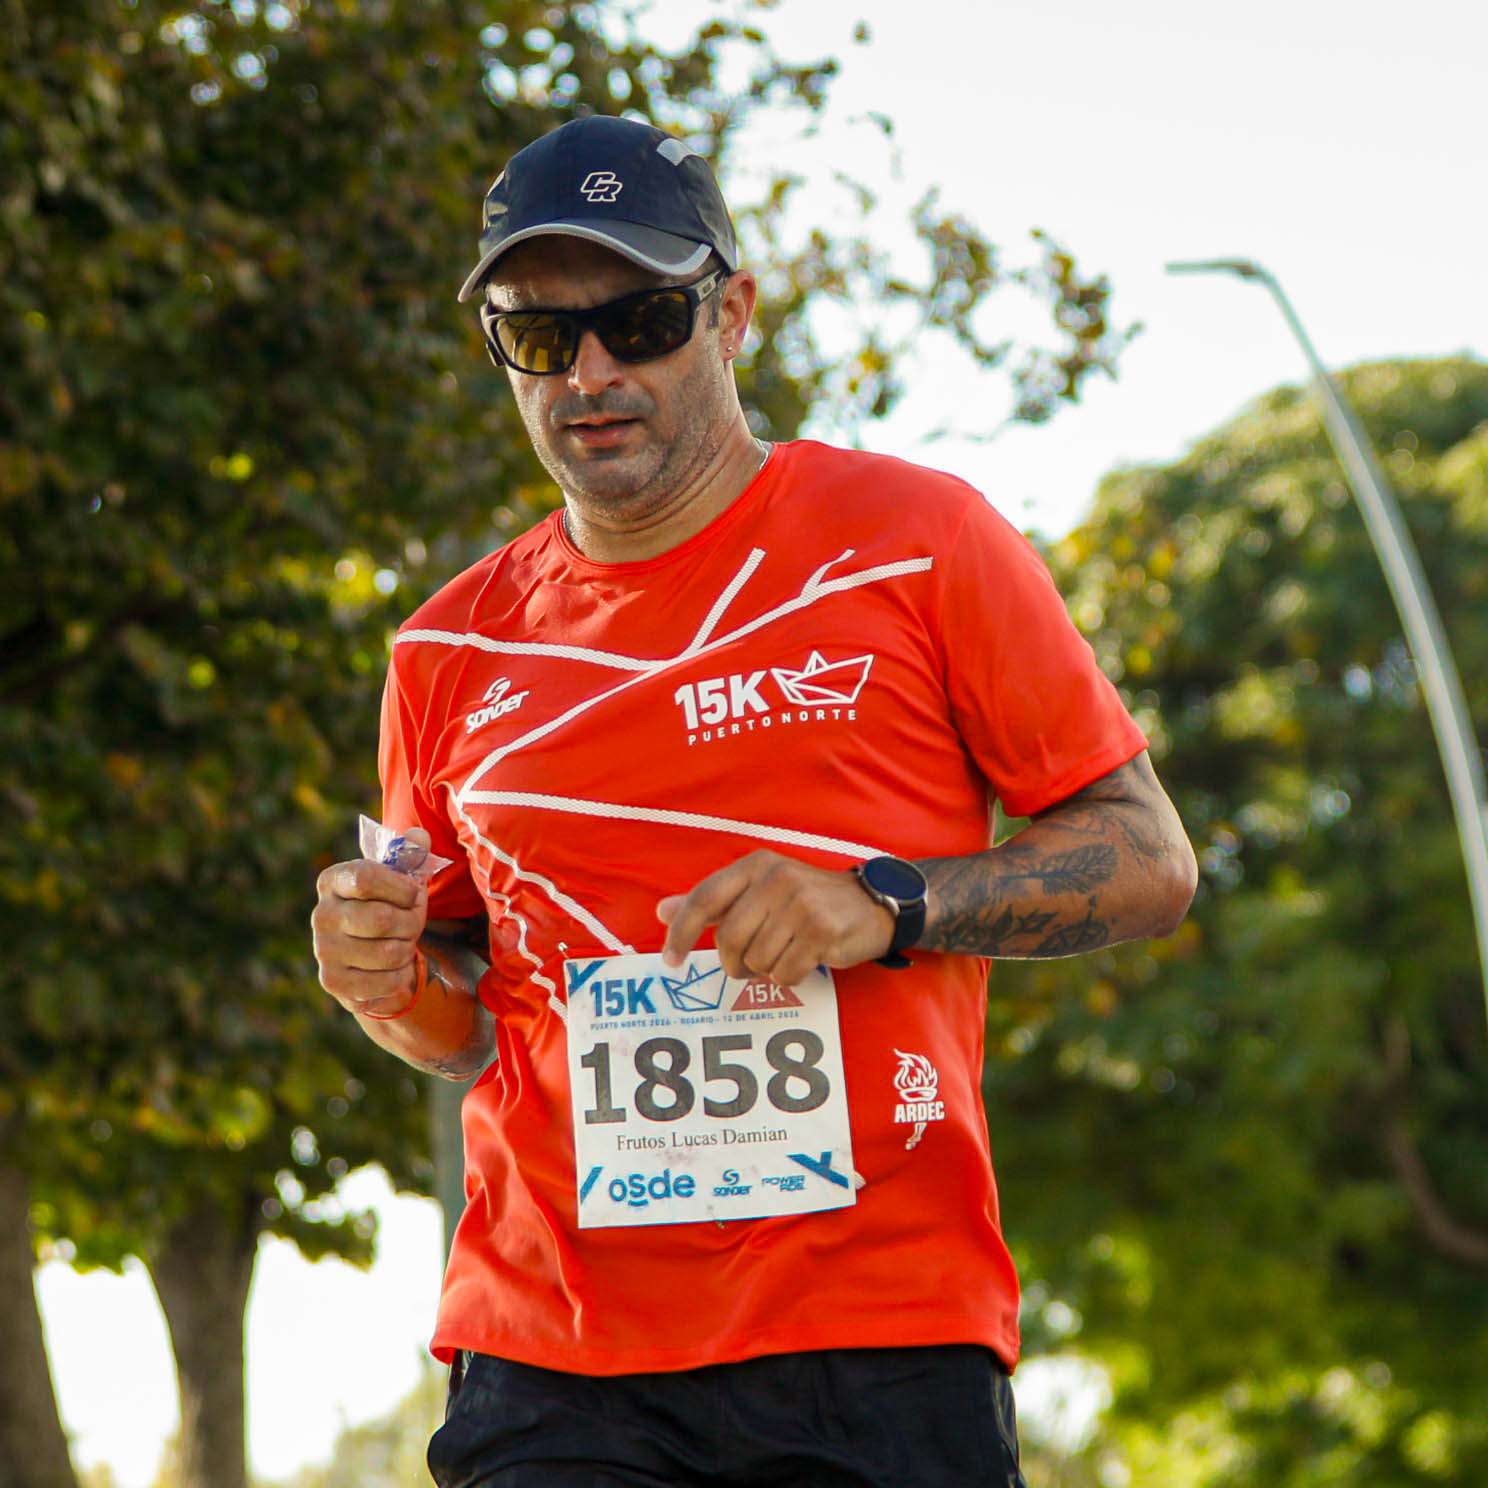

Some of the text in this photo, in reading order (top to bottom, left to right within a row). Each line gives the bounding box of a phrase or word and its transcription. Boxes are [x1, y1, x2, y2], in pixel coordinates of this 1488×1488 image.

[674, 670, 771, 730] 15K
[687, 708, 857, 746] PUERTO NORTE
[589, 976, 657, 1017] 15K
[745, 983, 787, 1004] 15K
[735, 1013, 746, 1022] DE
[580, 1028, 831, 1125] 1858
[894, 1101, 945, 1123] ARDEC
[616, 1126, 789, 1151] Frutos Lucas Damian
[608, 1167, 697, 1204] osde
